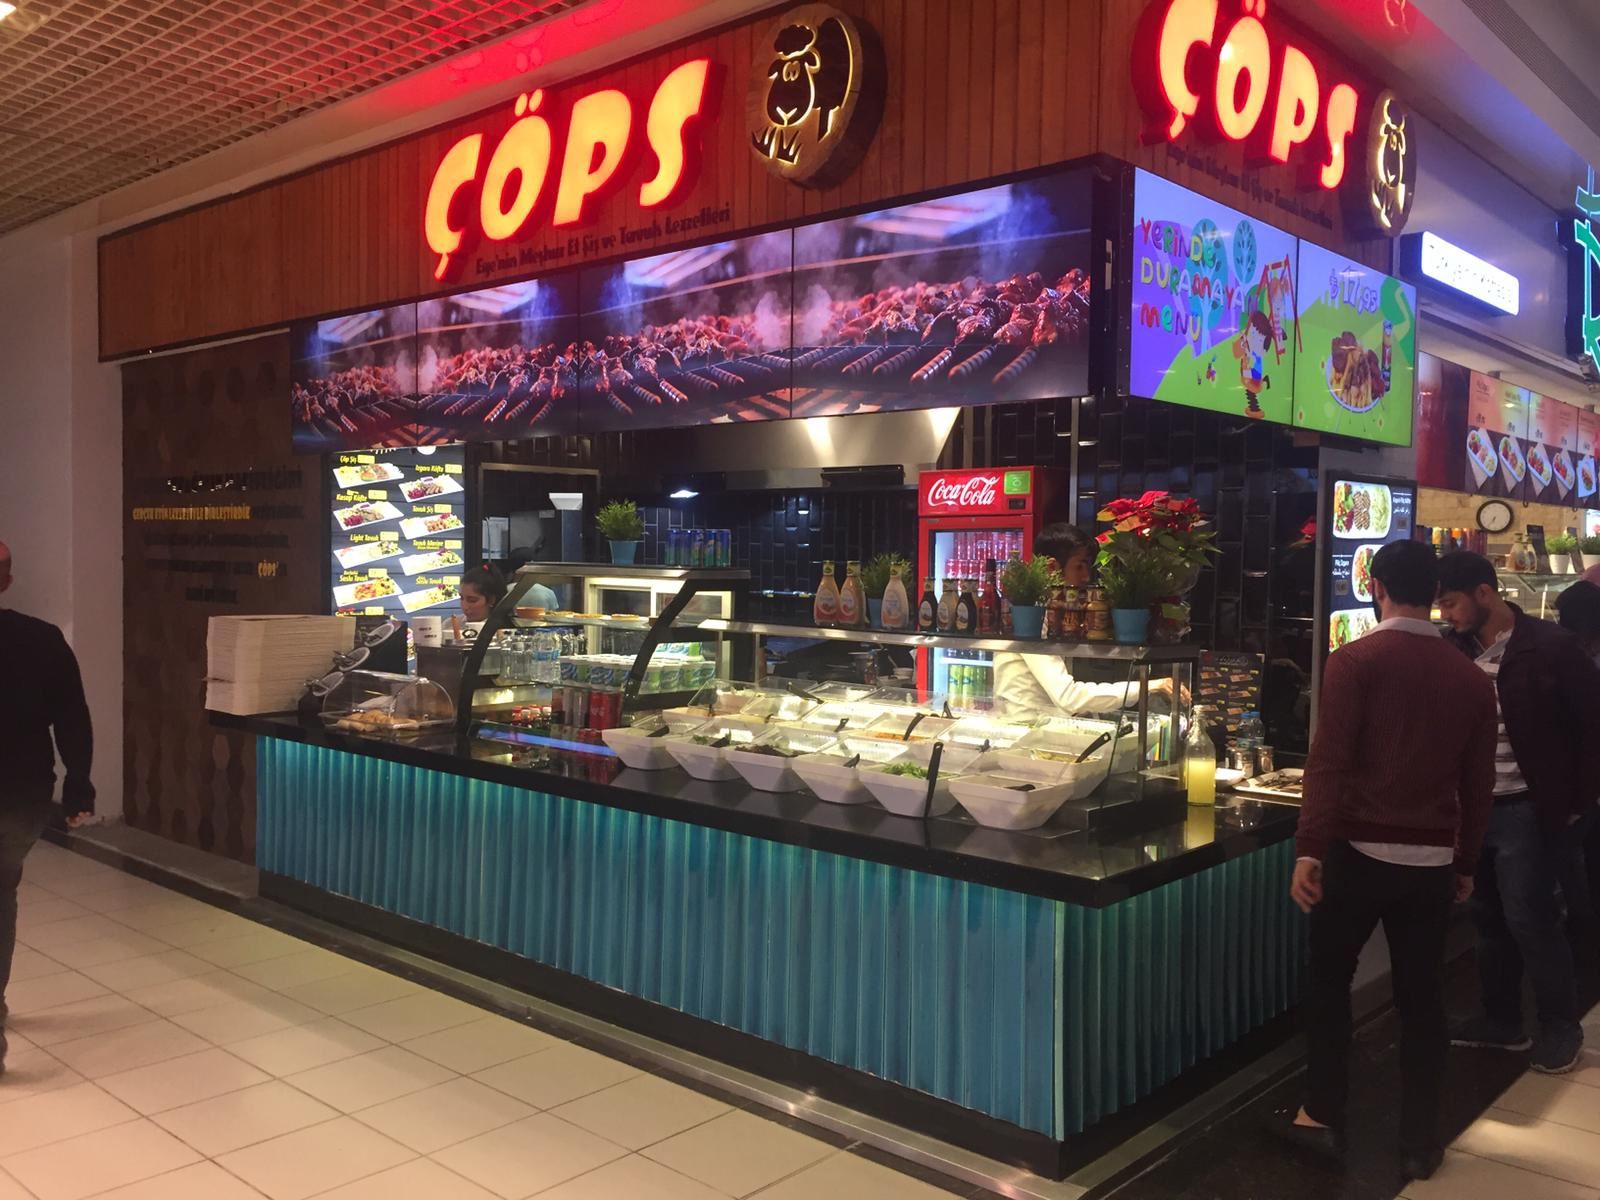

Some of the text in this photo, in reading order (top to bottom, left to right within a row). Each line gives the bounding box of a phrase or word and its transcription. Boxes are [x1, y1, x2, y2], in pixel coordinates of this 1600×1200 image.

[1159, 0, 1359, 190] ÇÖPS
[424, 58, 710, 281] ÇÖPS
[519, 244, 565, 266] Meşhur
[567, 236, 580, 255] Et
[602, 235, 617, 249] ve
[619, 221, 663, 243] Tavuk
[665, 203, 731, 236] Lezzetleri
[927, 476, 1001, 507] Coca-Cola
